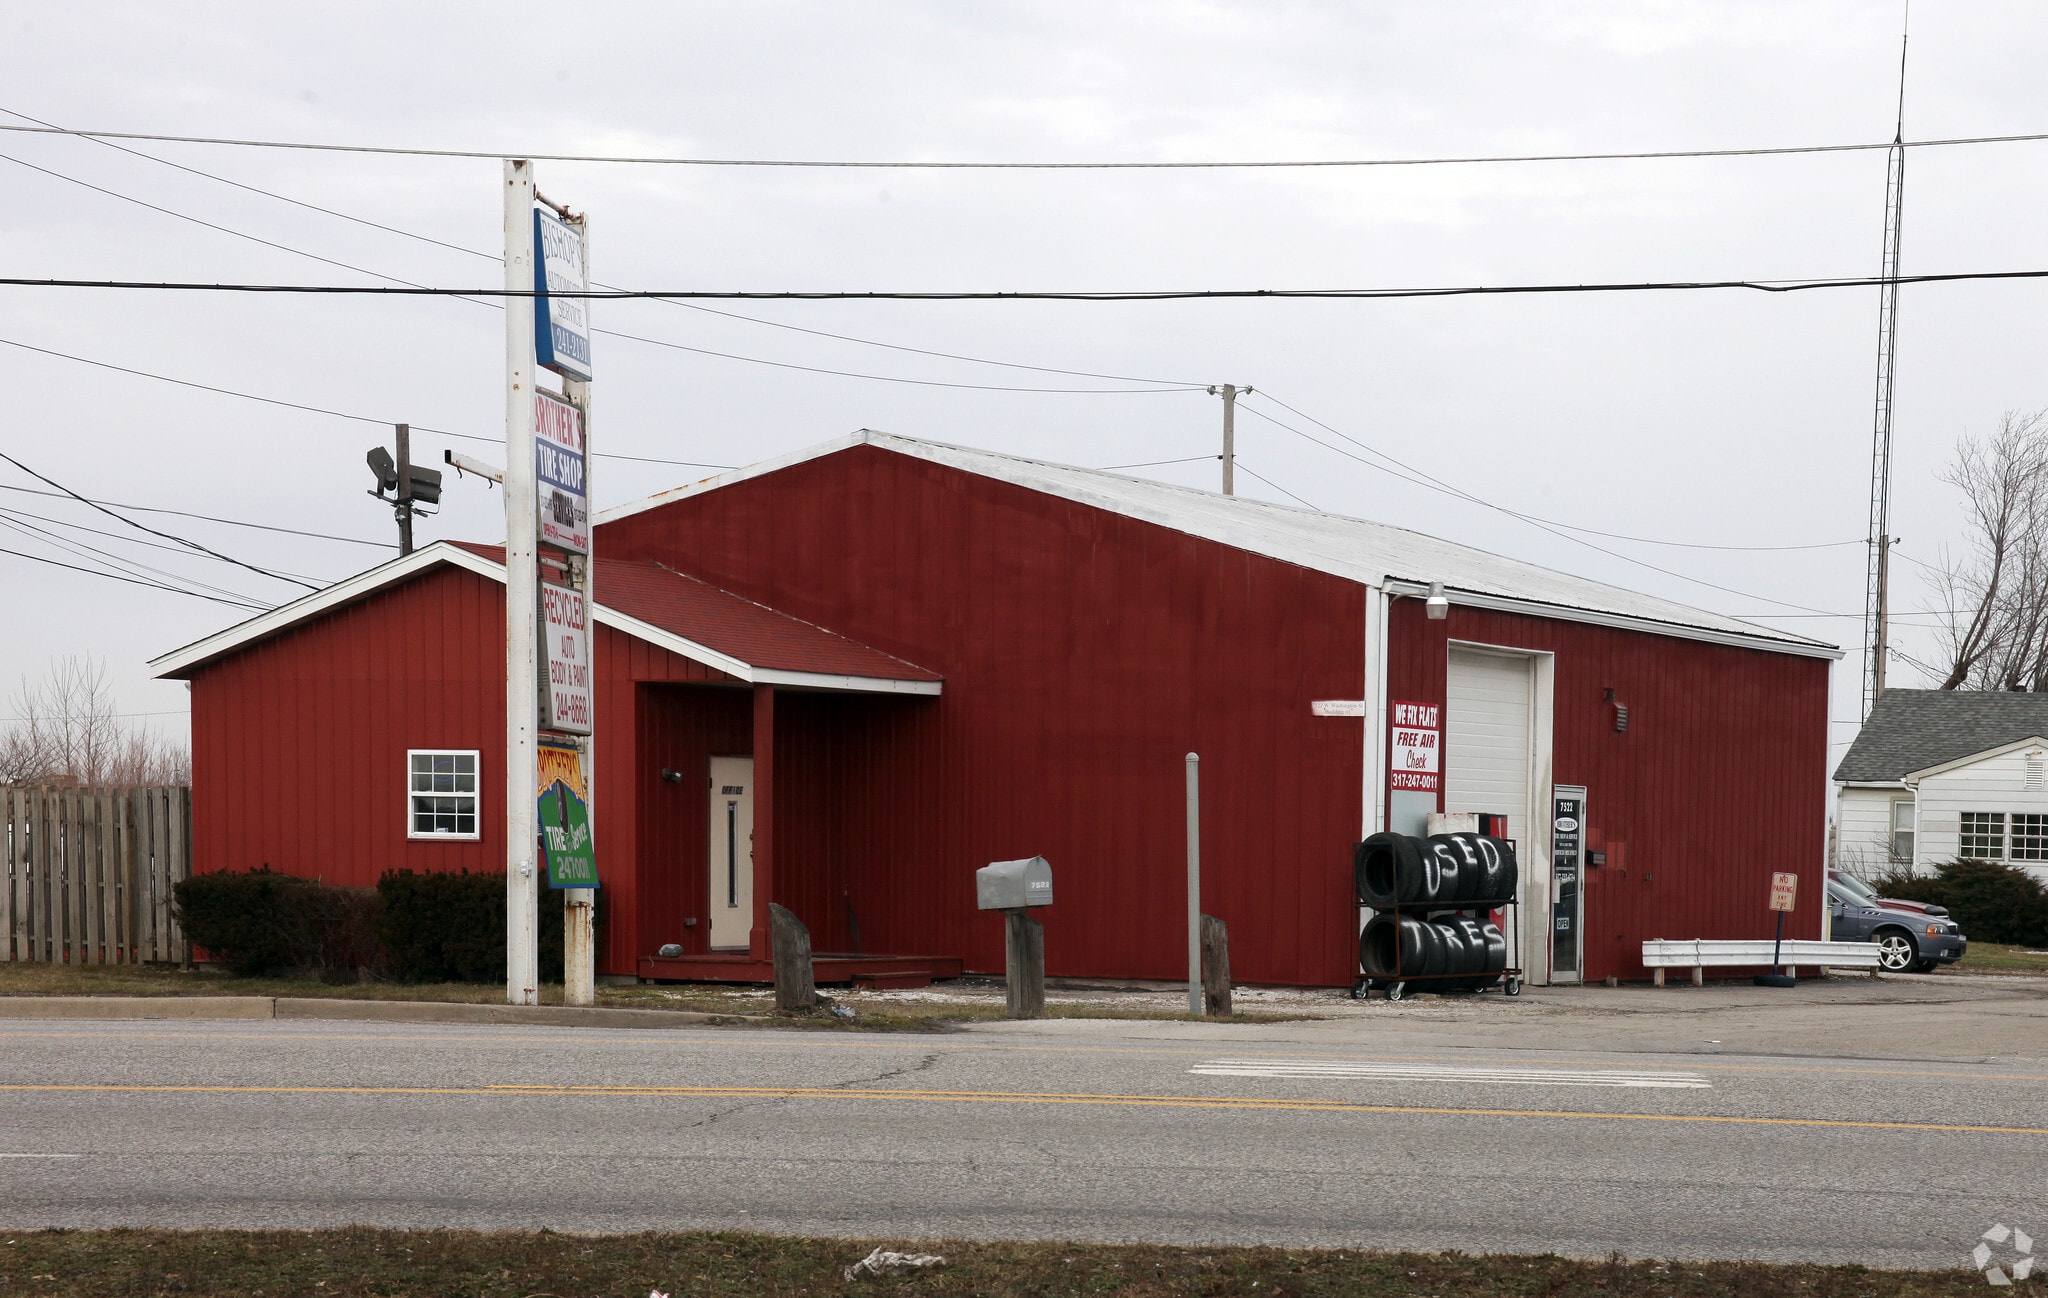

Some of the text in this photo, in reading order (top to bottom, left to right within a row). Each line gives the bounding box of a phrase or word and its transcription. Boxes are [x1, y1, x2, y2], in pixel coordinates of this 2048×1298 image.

[557, 299, 583, 328] SERVICE
[556, 327, 588, 362] 241-2131
[537, 443, 583, 490] TIRE SHOP
[543, 587, 585, 631] RECYCLED
[561, 635, 576, 660] AUTO
[550, 660, 567, 685] BODY
[573, 664, 587, 689] PAINT
[1395, 703, 1438, 728] WE FIX FLATS
[1397, 731, 1436, 748] FREE AIR
[1406, 749, 1427, 769] Check
[721, 785, 744, 795] OFFICE
[1392, 773, 1438, 789] 317-247-0011
[1560, 802, 1573, 812] 7522
[545, 825, 567, 851] TIRE
[1424, 836, 1500, 896] USED
[1773, 885, 1793, 893] PARKING
[1779, 876, 1789, 884] NO
[1557, 919, 1569, 928] OPEN
[1402, 920, 1505, 954] TIRES
